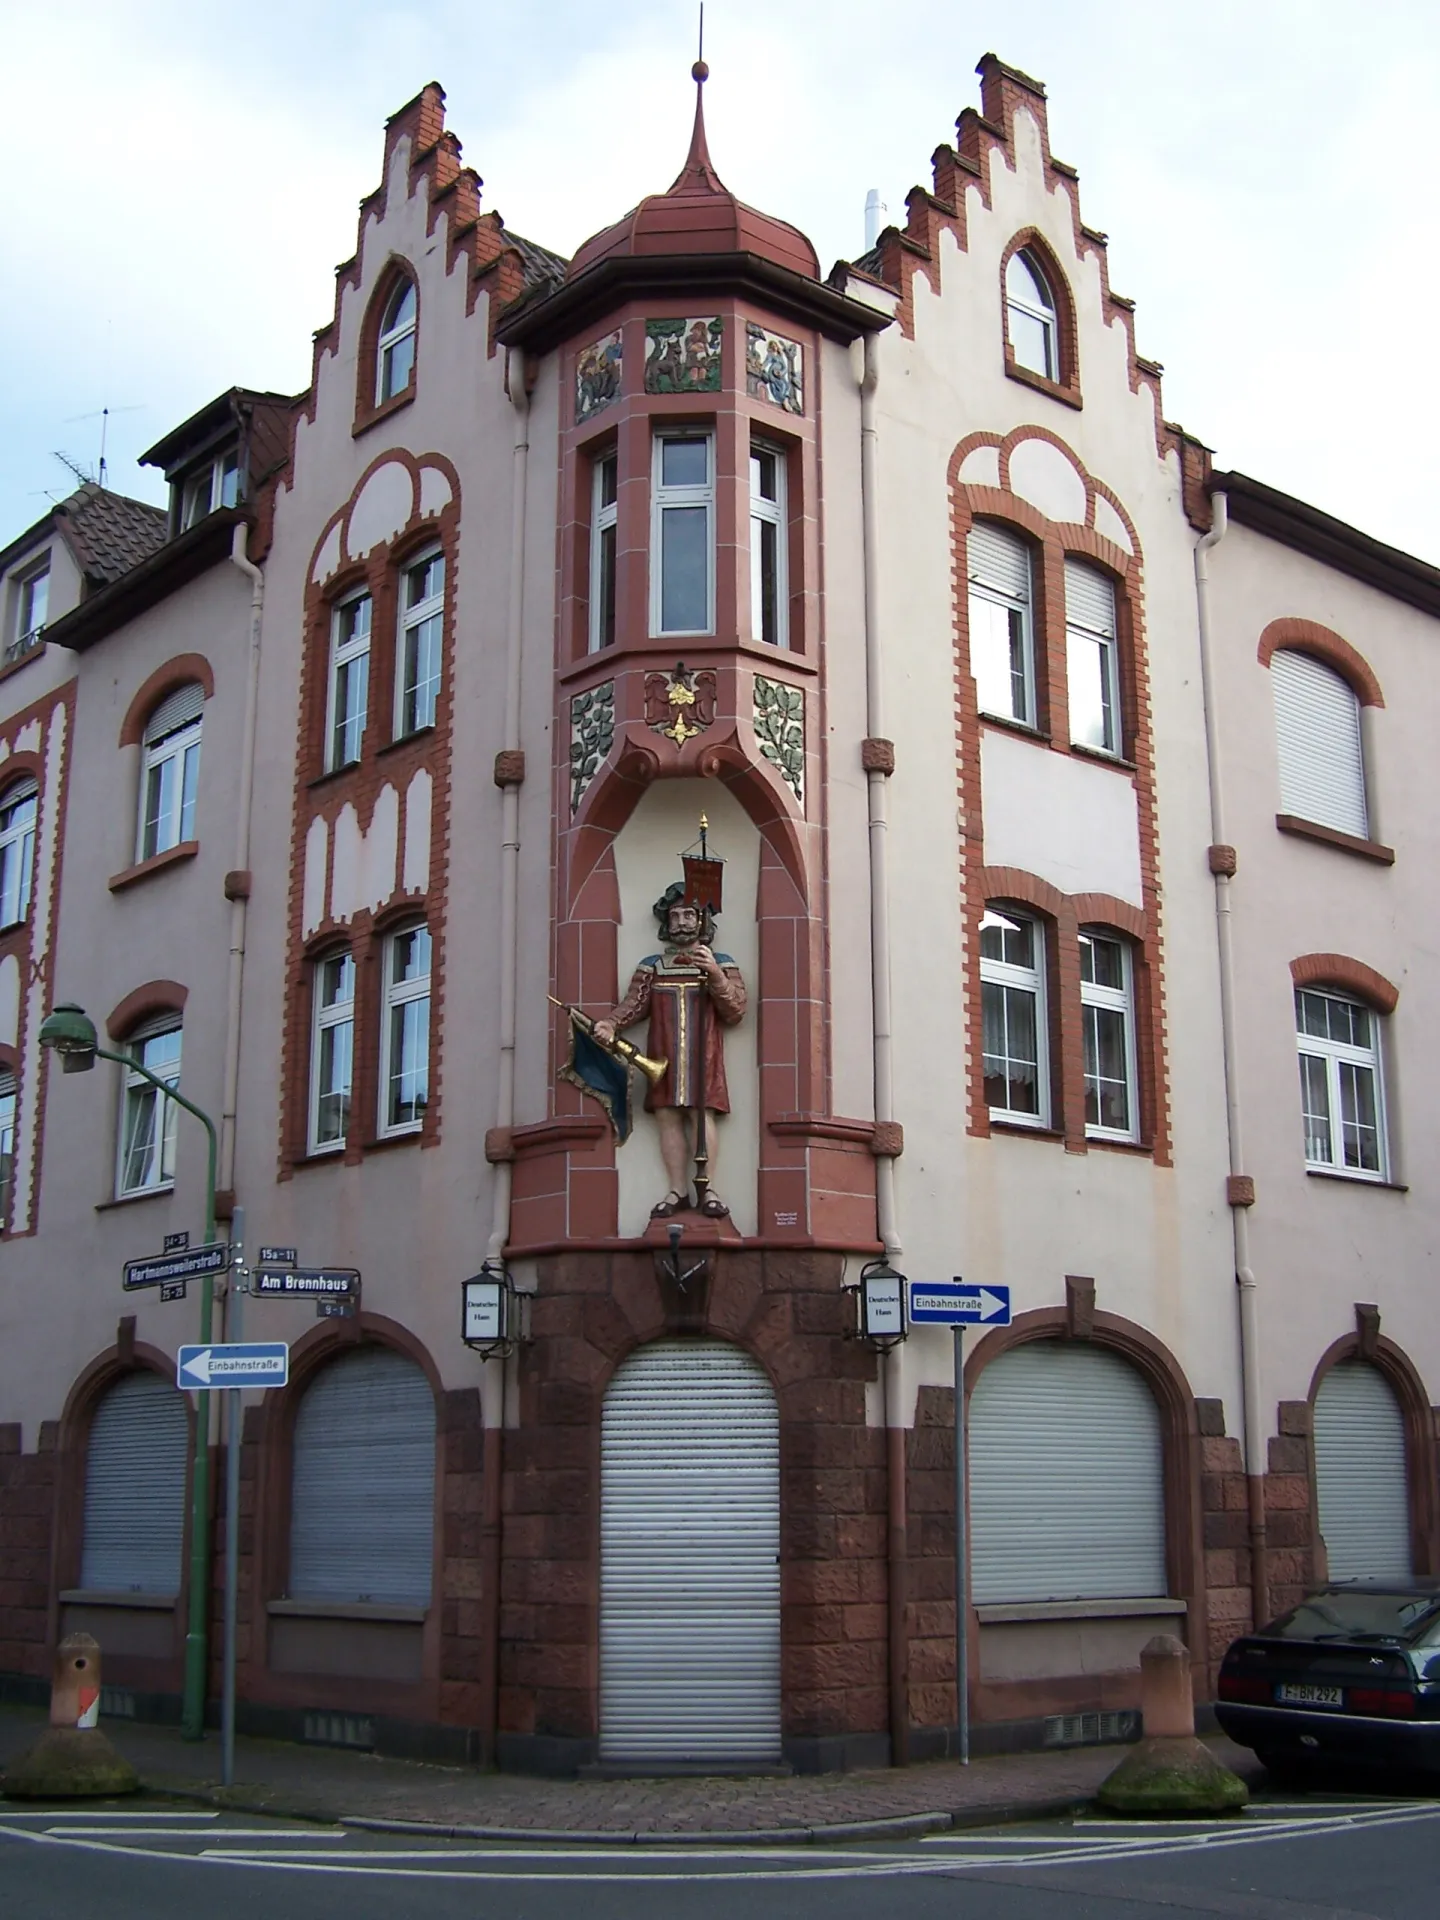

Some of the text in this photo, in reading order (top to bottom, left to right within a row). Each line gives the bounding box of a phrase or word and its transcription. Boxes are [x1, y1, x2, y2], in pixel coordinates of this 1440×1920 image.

[262, 1274, 348, 1291] Am Brennhaus
[915, 1297, 983, 1310] Einbahnstraße
[208, 1359, 279, 1371] Einbahnstraße
